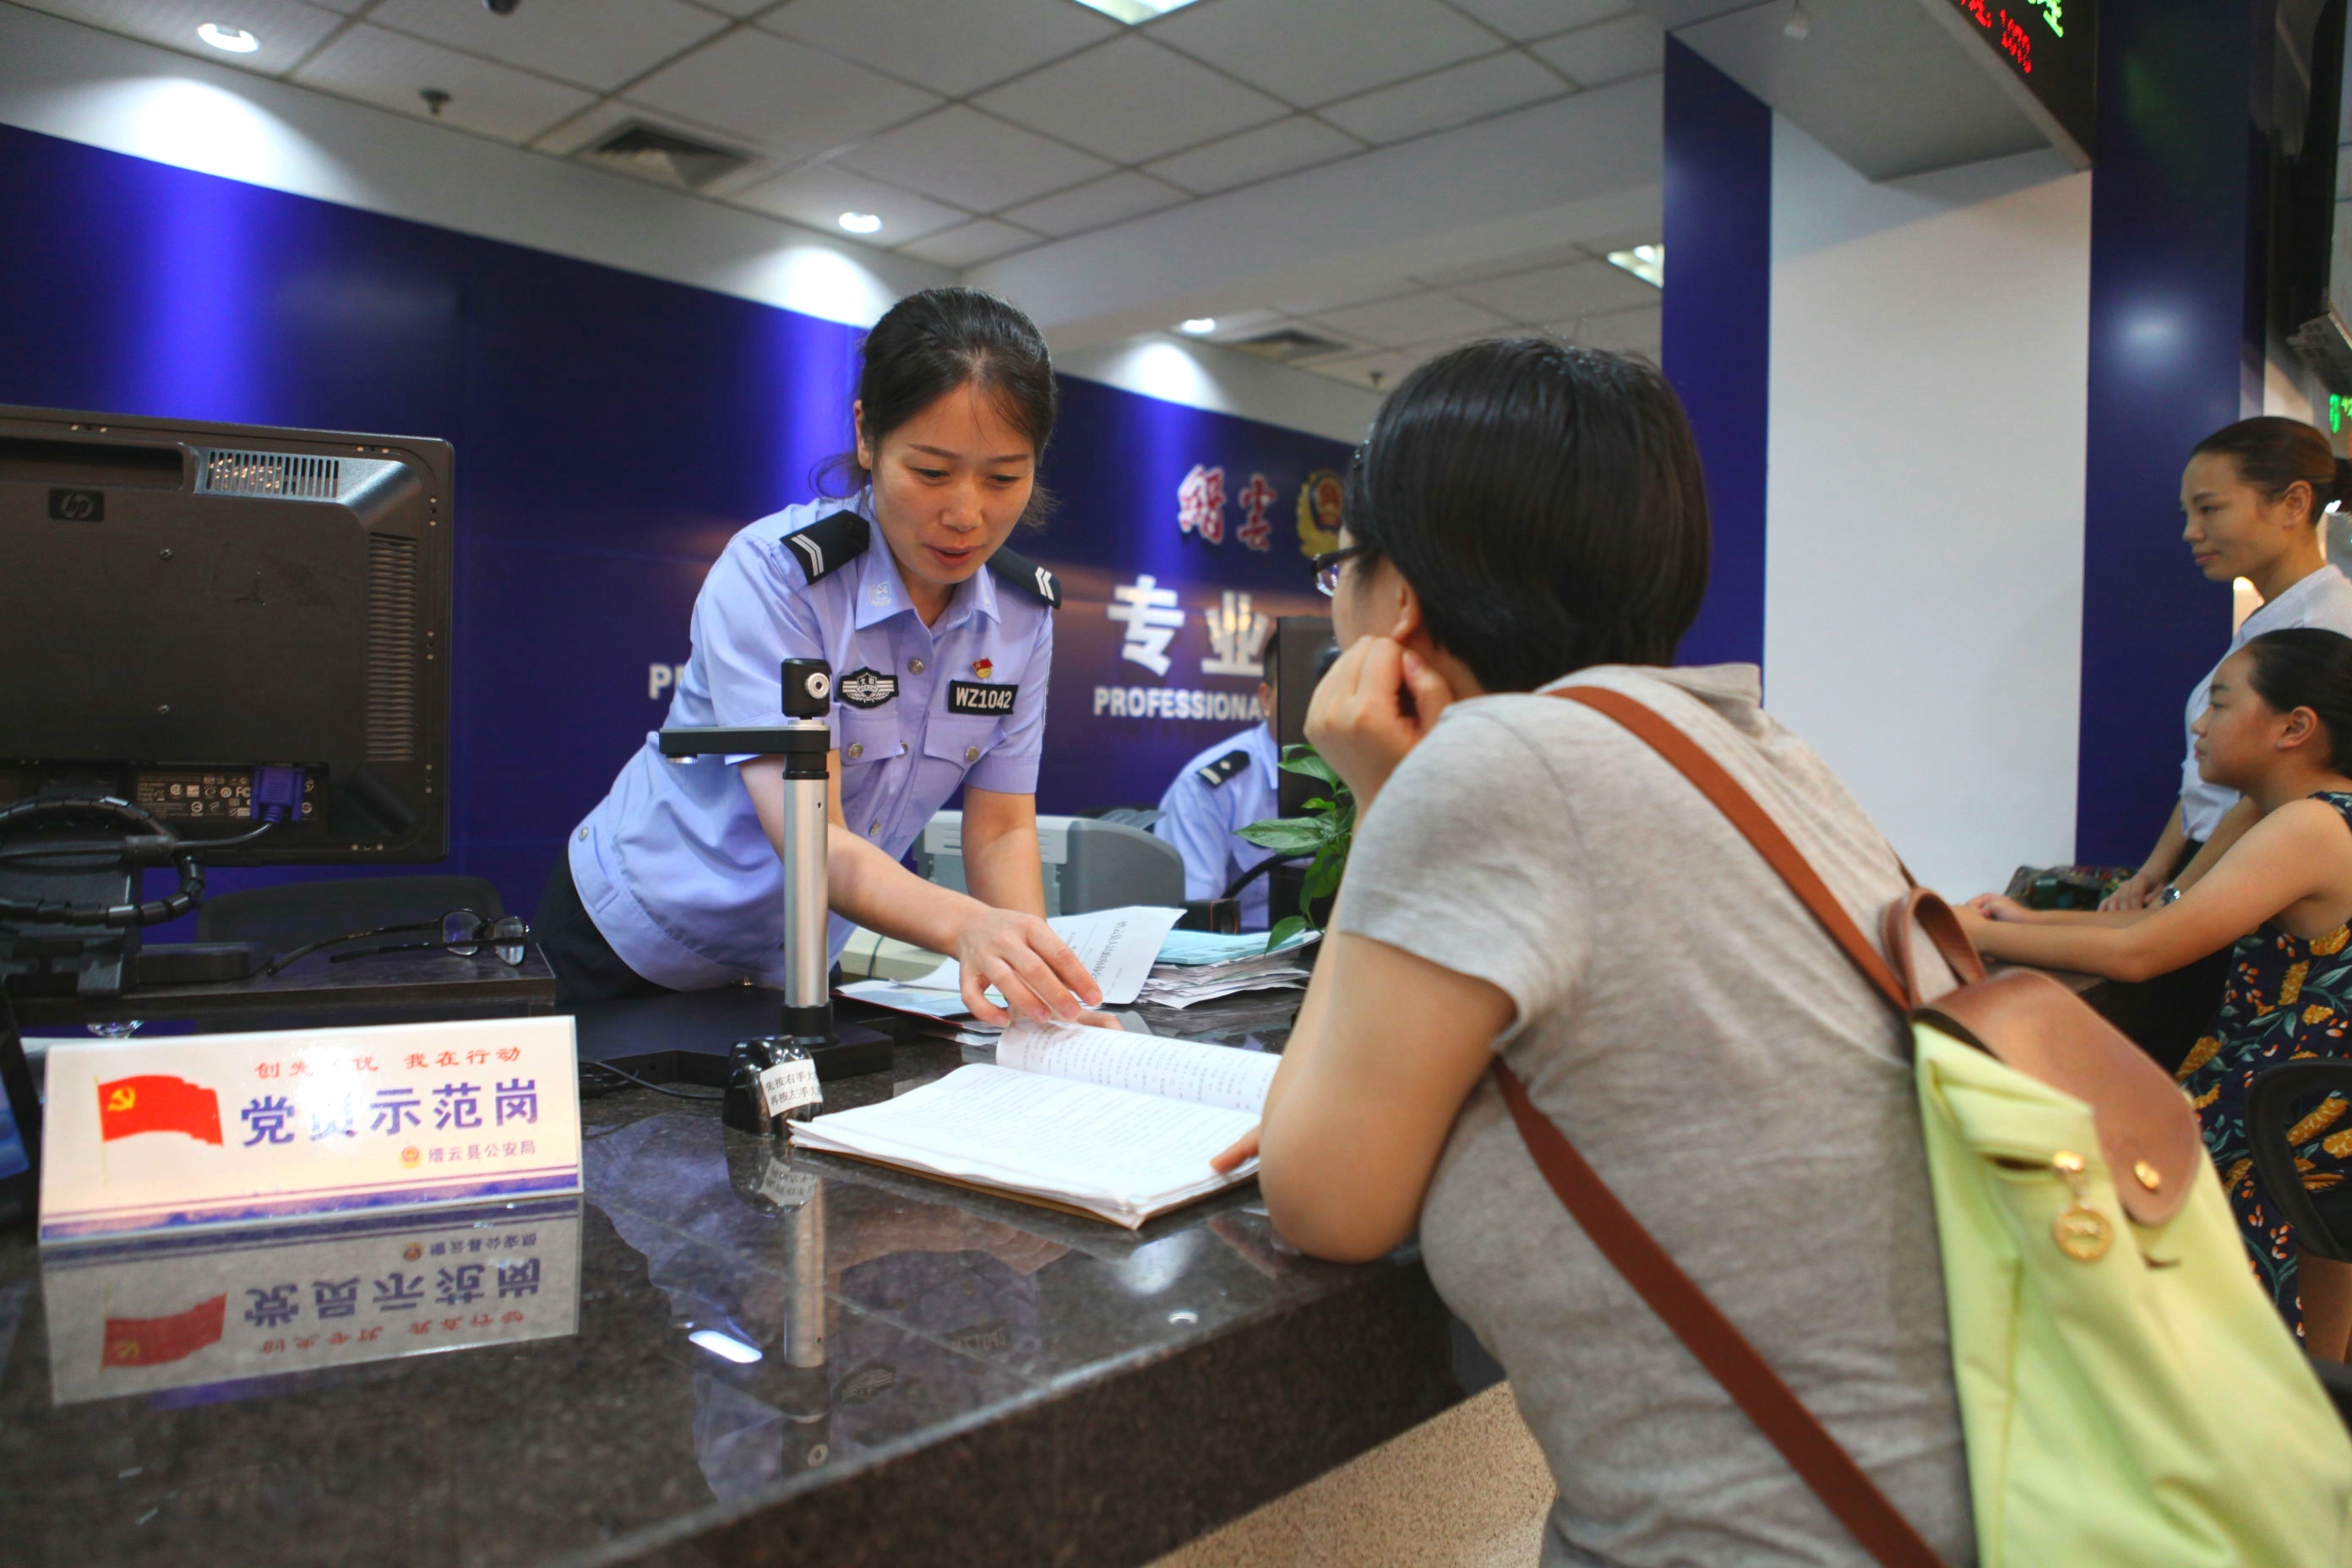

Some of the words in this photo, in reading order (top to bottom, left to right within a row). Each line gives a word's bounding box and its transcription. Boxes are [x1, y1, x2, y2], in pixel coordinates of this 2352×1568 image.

[1107, 574, 1267, 677] 专业
[649, 663, 684, 700] P
[956, 687, 1012, 709] WZ1042
[1093, 687, 1262, 721] PROFESSIONA
[255, 1054, 379, 1079] 创先优
[404, 1047, 521, 1069] 我在行动
[428, 1141, 536, 1163] 缙云县公安局
